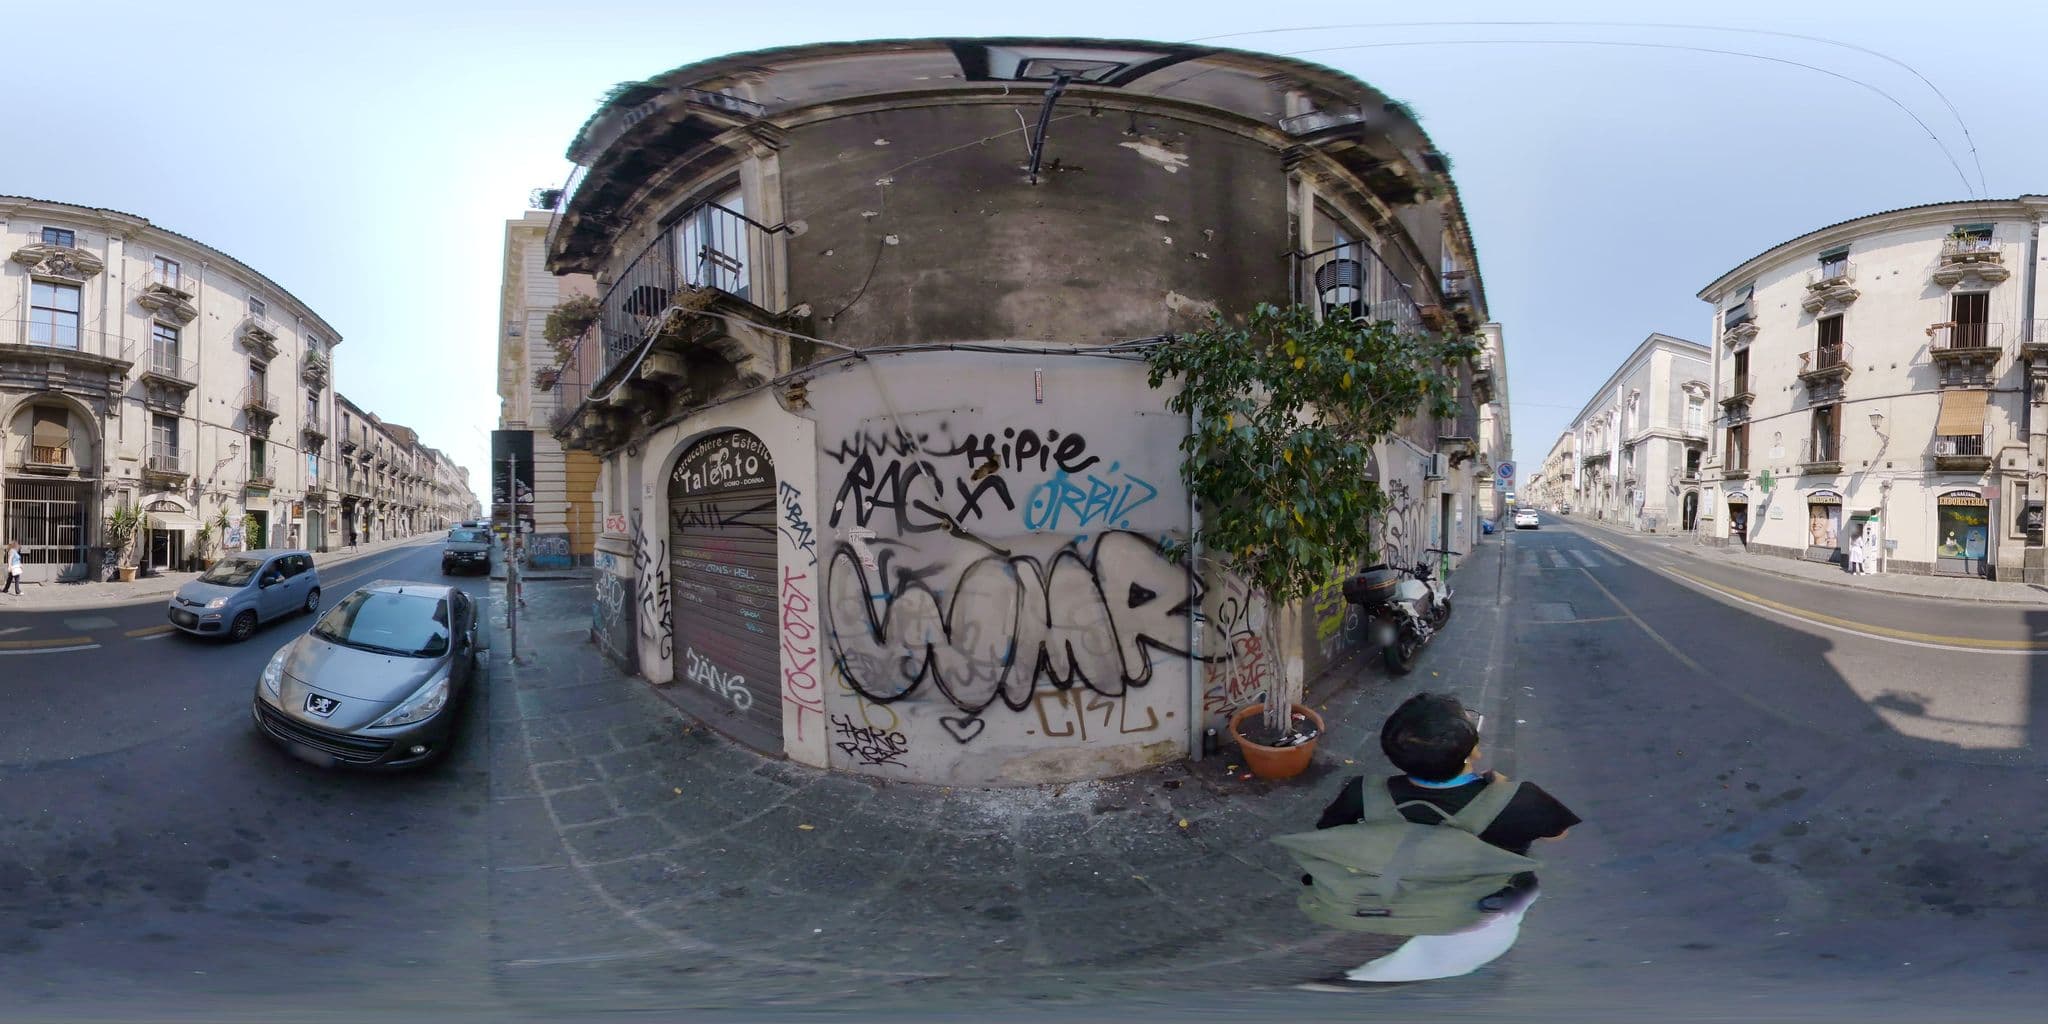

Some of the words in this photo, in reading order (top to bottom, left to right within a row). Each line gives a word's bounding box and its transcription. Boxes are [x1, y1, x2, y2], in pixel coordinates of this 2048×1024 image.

[732, 433, 774, 467] Estetica
[681, 447, 758, 493] Talento
[744, 477, 765, 486] DONNA
[1939, 497, 1988, 506] ERBORISTERIA
